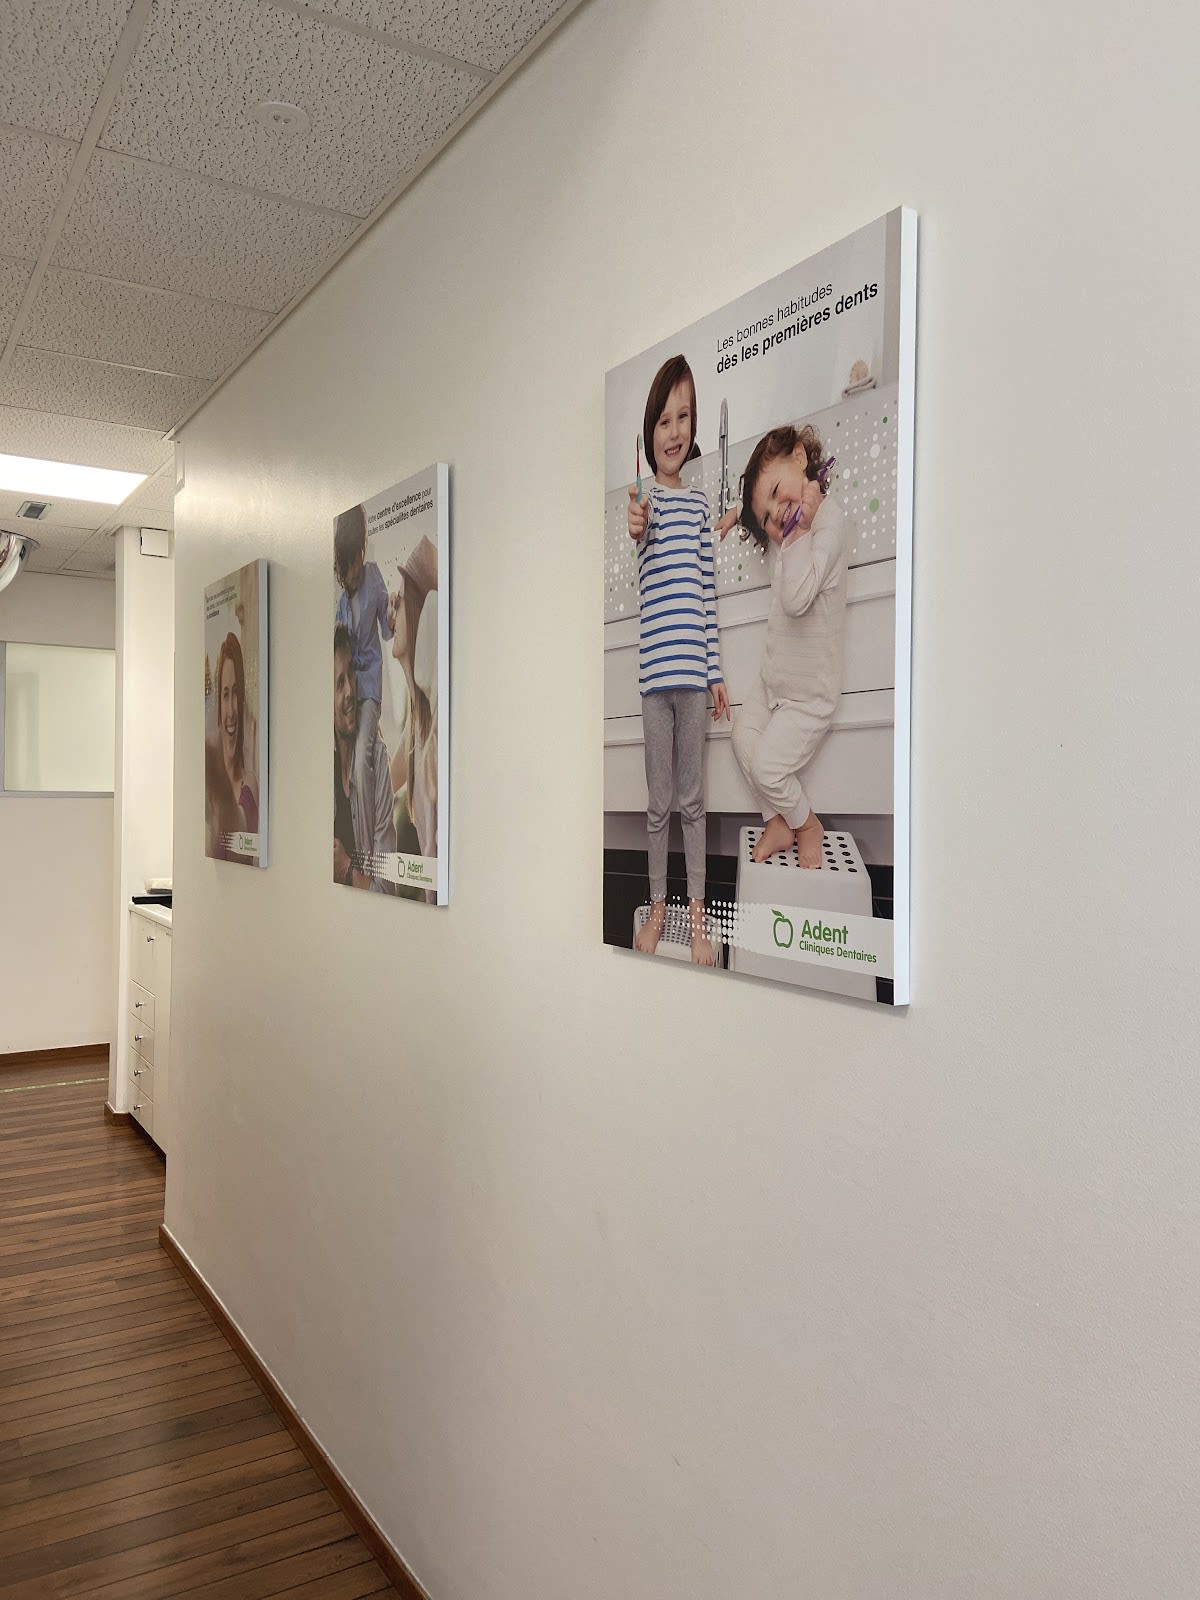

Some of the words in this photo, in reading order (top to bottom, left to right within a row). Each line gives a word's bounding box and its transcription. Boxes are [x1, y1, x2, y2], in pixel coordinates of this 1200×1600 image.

[716, 354, 738, 373] dès
[741, 342, 759, 361] les
[762, 307, 831, 355] premières
[835, 283, 878, 315] dents
[717, 335, 734, 352] Les
[736, 313, 774, 342] bonnes
[777, 283, 833, 322] habitudes
[377, 506, 391, 520] centre
[392, 491, 421, 513] d'excellence
[421, 487, 432, 501] pour
[410, 500, 434, 518] dentaires
[407, 860, 424, 874] Adent
[801, 919, 849, 945] Adent
[799, 940, 835, 956] Cliniques
[836, 946, 877, 963] Dentaires
